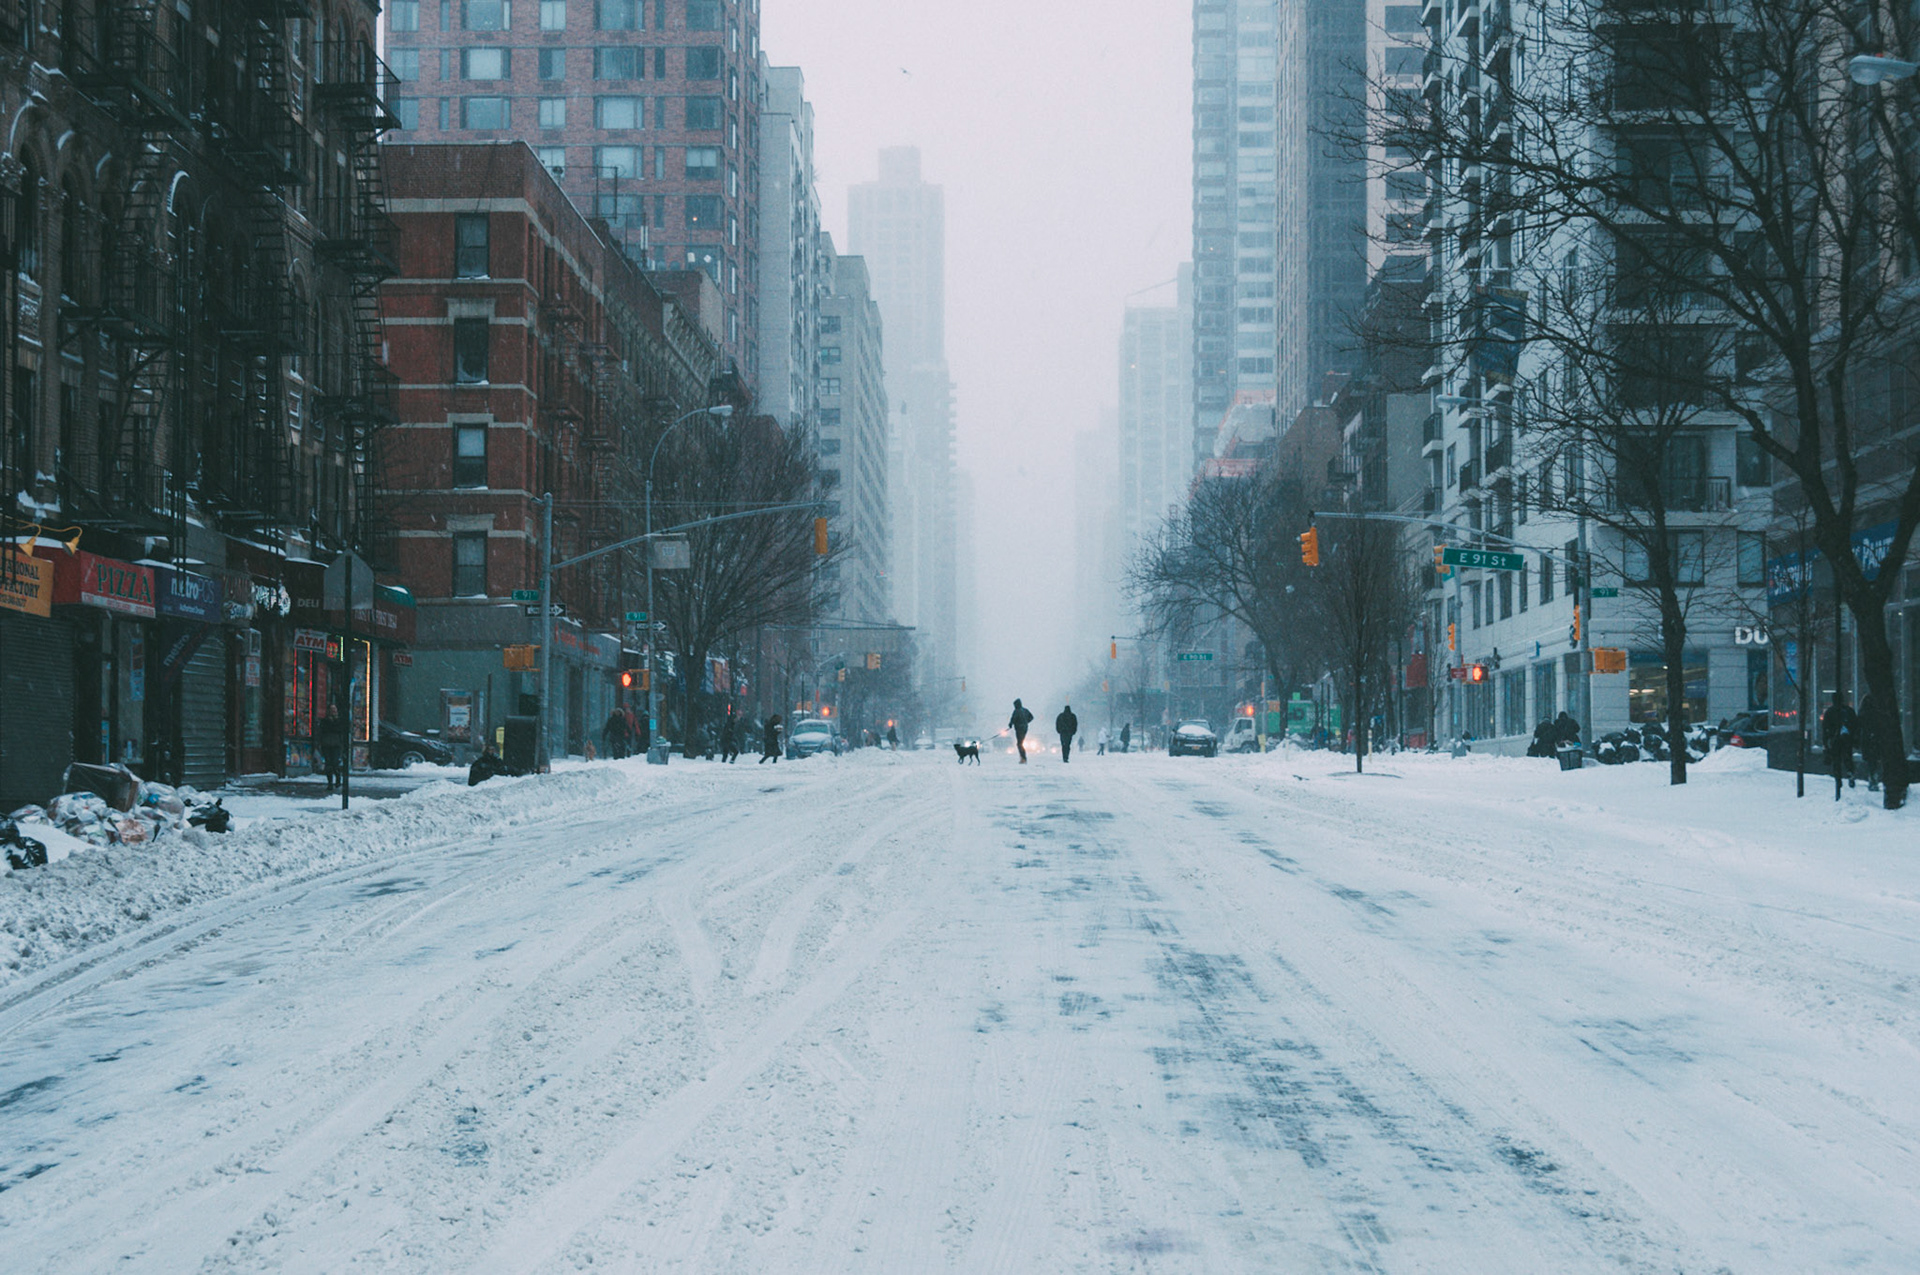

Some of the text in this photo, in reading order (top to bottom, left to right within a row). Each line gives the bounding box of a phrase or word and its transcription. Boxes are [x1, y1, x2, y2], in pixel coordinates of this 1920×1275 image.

[1459, 552, 1506, 566] E 91 St
[97, 564, 151, 603] PIZZA
[523, 591, 532, 600] 91
[297, 598, 319, 608] DELI
[295, 635, 325, 649] ATM
[1734, 626, 1769, 645] DU
[162, 634, 191, 667] metro
[393, 654, 413, 666] ATM
